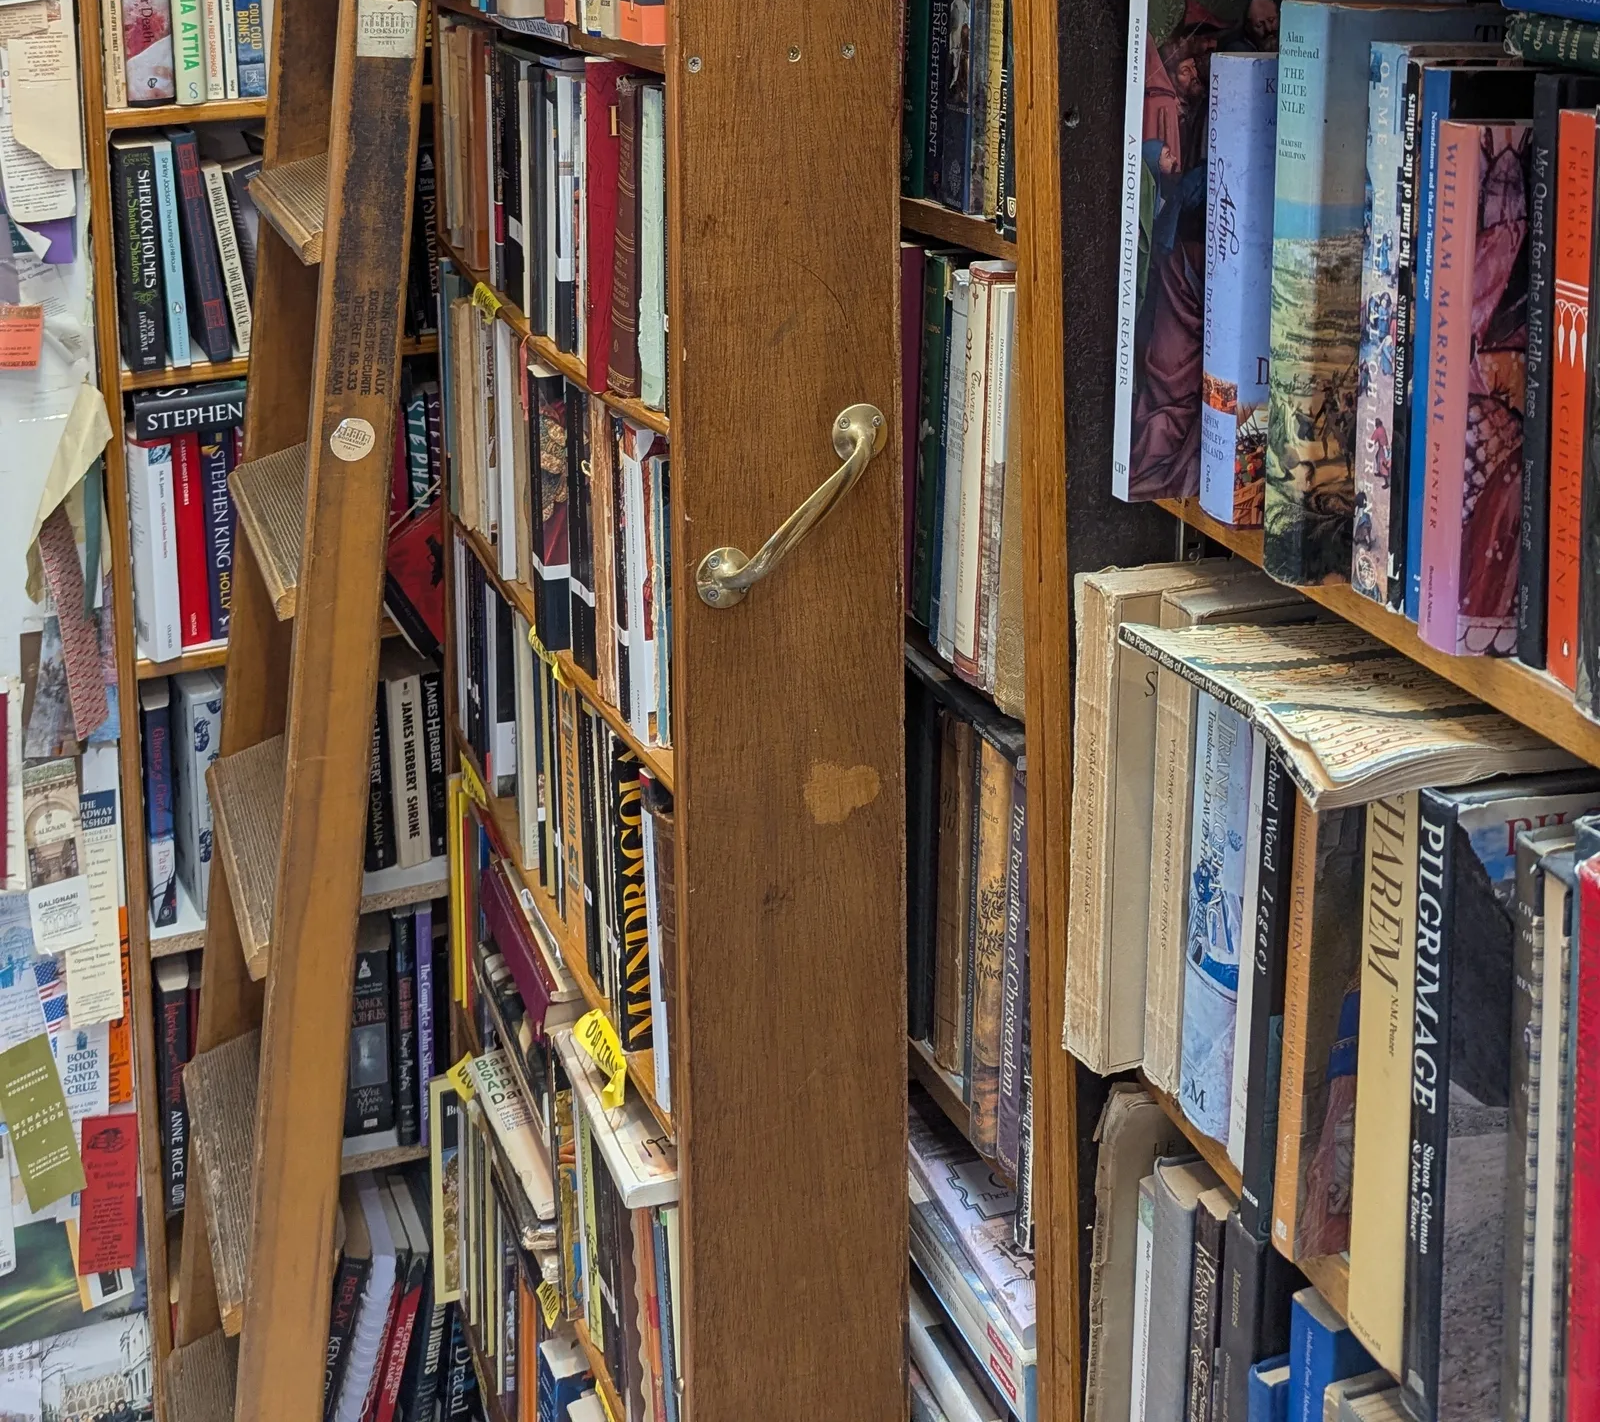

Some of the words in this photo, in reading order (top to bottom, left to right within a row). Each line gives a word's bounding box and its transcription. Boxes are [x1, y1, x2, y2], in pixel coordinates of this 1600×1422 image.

[181, 21, 201, 72] ATTIA
[236, 9, 252, 45] BONES
[364, 27, 411, 35] BOOKSHOP
[1131, 16, 1142, 85] ROSENWEIN
[928, 1, 942, 157] ENLIGHTENMENT
[1280, 82, 1308, 98] BLUE
[1283, 67, 1306, 82] THE
[1280, 99, 1306, 116] NILE
[1375, 60, 1392, 149] ORME
[1404, 92, 1417, 156] Cathars
[1427, 111, 1438, 173] Nostradamus
[1535, 146, 1550, 177] My
[137, 168, 156, 230] SHERLOCK
[1125, 152, 1137, 215] SHORT
[1439, 143, 1459, 271] WILLIAM
[1534, 179, 1549, 231] Quest
[1564, 145, 1578, 260] FREEMAN
[1577, 149, 1590, 260] CHARLES
[1400, 201, 1413, 240] Land
[142, 230, 158, 290] HOLMES
[1120, 218, 1135, 313] MEDIEVAL
[1532, 235, 1547, 270] for
[351, 295, 366, 349] DECRET
[1528, 304, 1544, 371] Middle
[1118, 314, 1132, 388] READER
[1431, 287, 1451, 426] MARSHAL
[374, 368, 387, 396] AUX
[1523, 379, 1540, 419] Ages
[146, 400, 244, 432] STEPHEN
[209, 449, 230, 525] STEPHEN
[213, 524, 232, 569] KING
[400, 699, 414, 738] JAMES
[423, 678, 440, 719] JAMES
[403, 736, 418, 793] HERBERT
[426, 717, 443, 774] HERBERT
[563, 732, 580, 843] DECAMERON
[406, 794, 420, 840] SHRINE
[1262, 818, 1281, 873] Wood
[38, 892, 79, 910] GALIGNANI
[1006, 837, 1025, 943] Formation
[1367, 799, 1408, 995] HAREM
[1254, 886, 1277, 976] Legacy
[1413, 815, 1446, 1115] PILGRIMAGE
[66, 1049, 99, 1065] BOOK
[1000, 971, 1020, 1100] Christendom
[1387, 1022, 1399, 1058] Penzer
[63, 1069, 101, 1087] SANTA
[66, 1060, 99, 1077] SHOP
[66, 1081, 99, 1096] CRUZ
[14, 1110, 66, 1142] JACKSON
[170, 1109, 183, 1145] ANNE
[171, 1146, 184, 1183] RICE
[1421, 1141, 1436, 1192] Simon
[977, 1191, 1011, 1202] Their
[1418, 1192, 1435, 1255] Coleman
[424, 1327, 444, 1376] NIGHTS
[450, 1345, 472, 1416] Dracul
